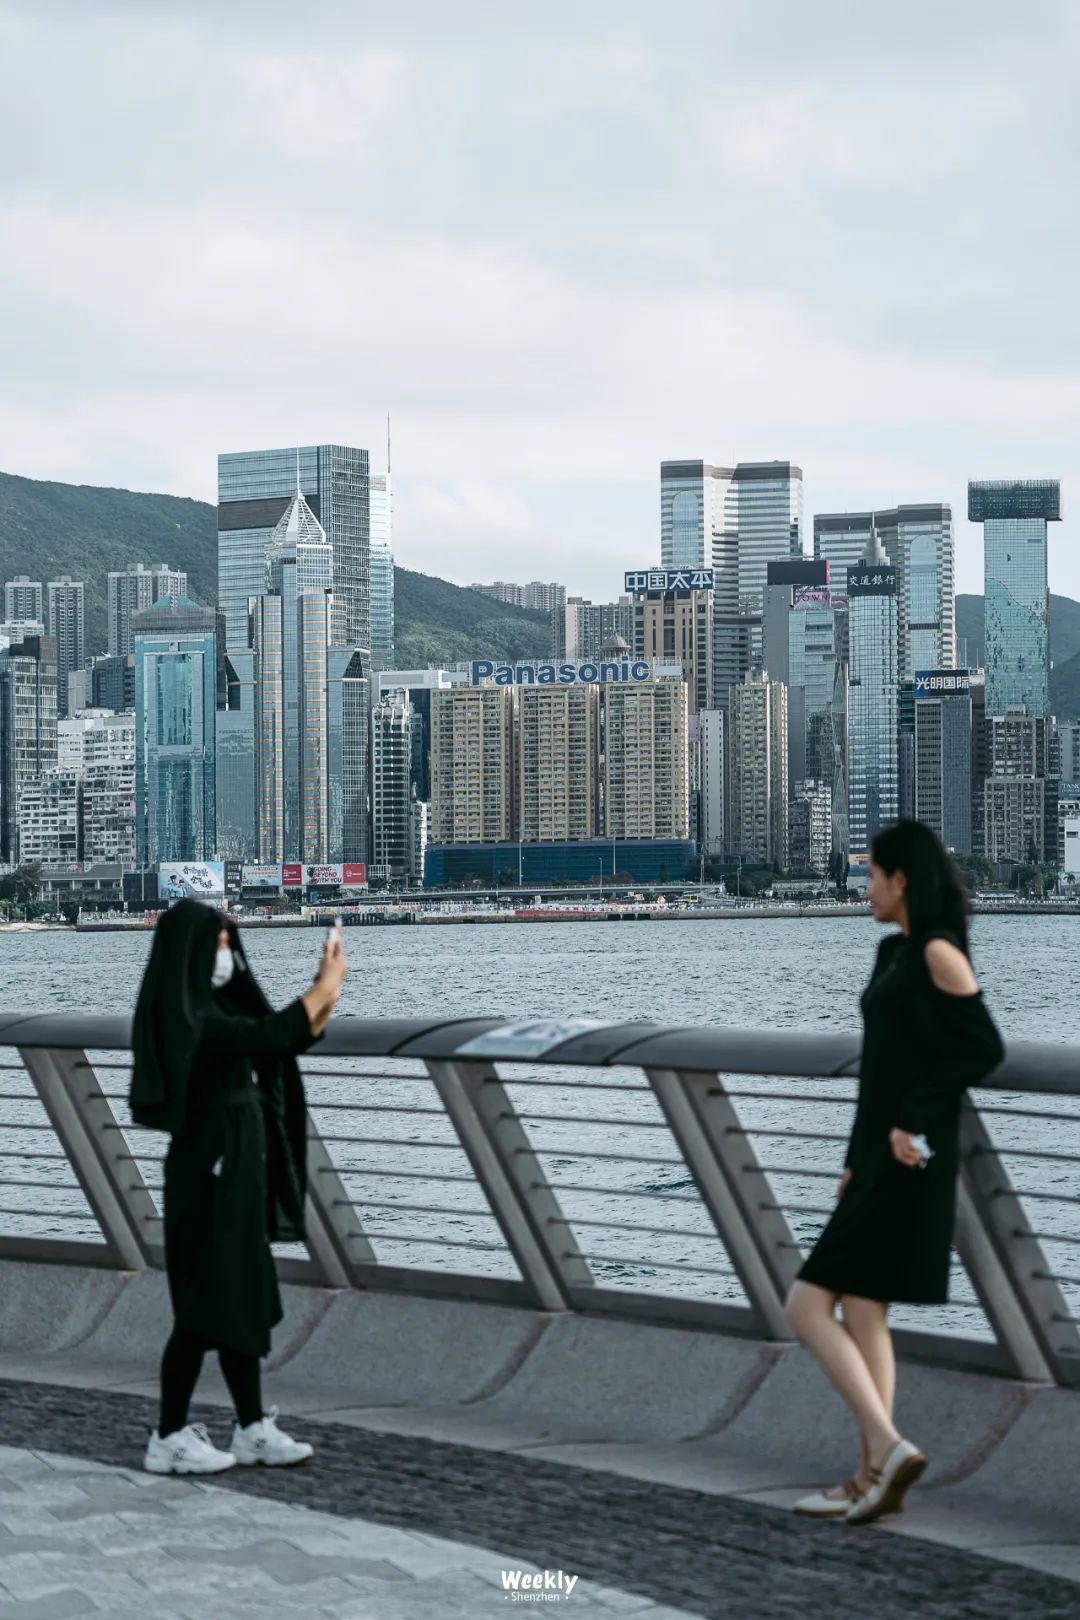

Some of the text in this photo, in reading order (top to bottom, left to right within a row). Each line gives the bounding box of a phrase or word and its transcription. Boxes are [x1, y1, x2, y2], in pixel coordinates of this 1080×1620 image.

[626, 571, 712, 590] 中国太平
[849, 575, 896, 586] 交通銀行
[472, 656, 650, 686] Panasonic
[916, 676, 969, 690] 光明国际
